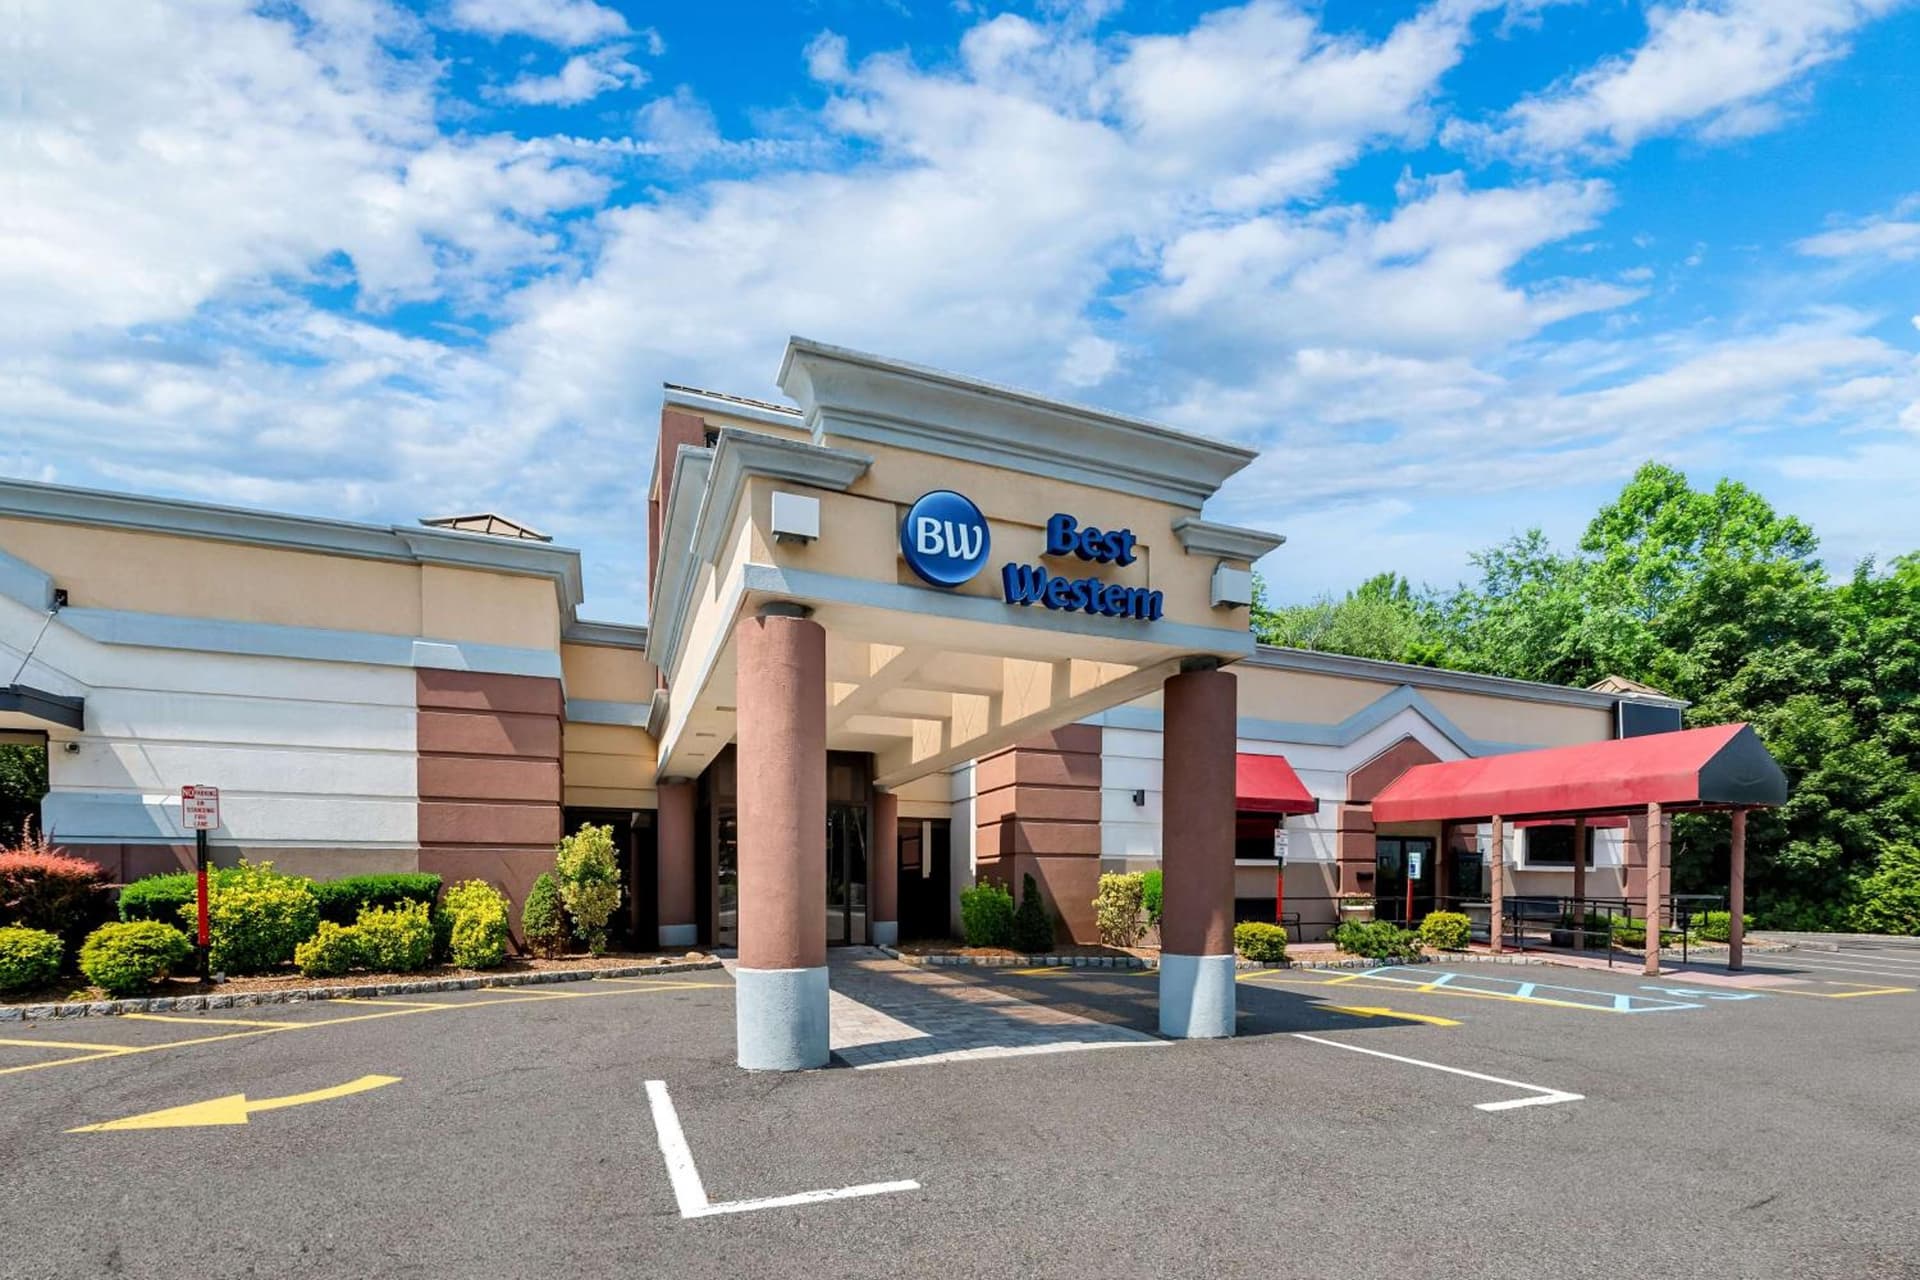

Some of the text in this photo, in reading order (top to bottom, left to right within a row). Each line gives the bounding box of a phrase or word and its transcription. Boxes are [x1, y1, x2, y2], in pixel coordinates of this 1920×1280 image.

[917, 516, 983, 560] BW
[1046, 513, 1138, 567] Best
[1001, 562, 1164, 622] Western
